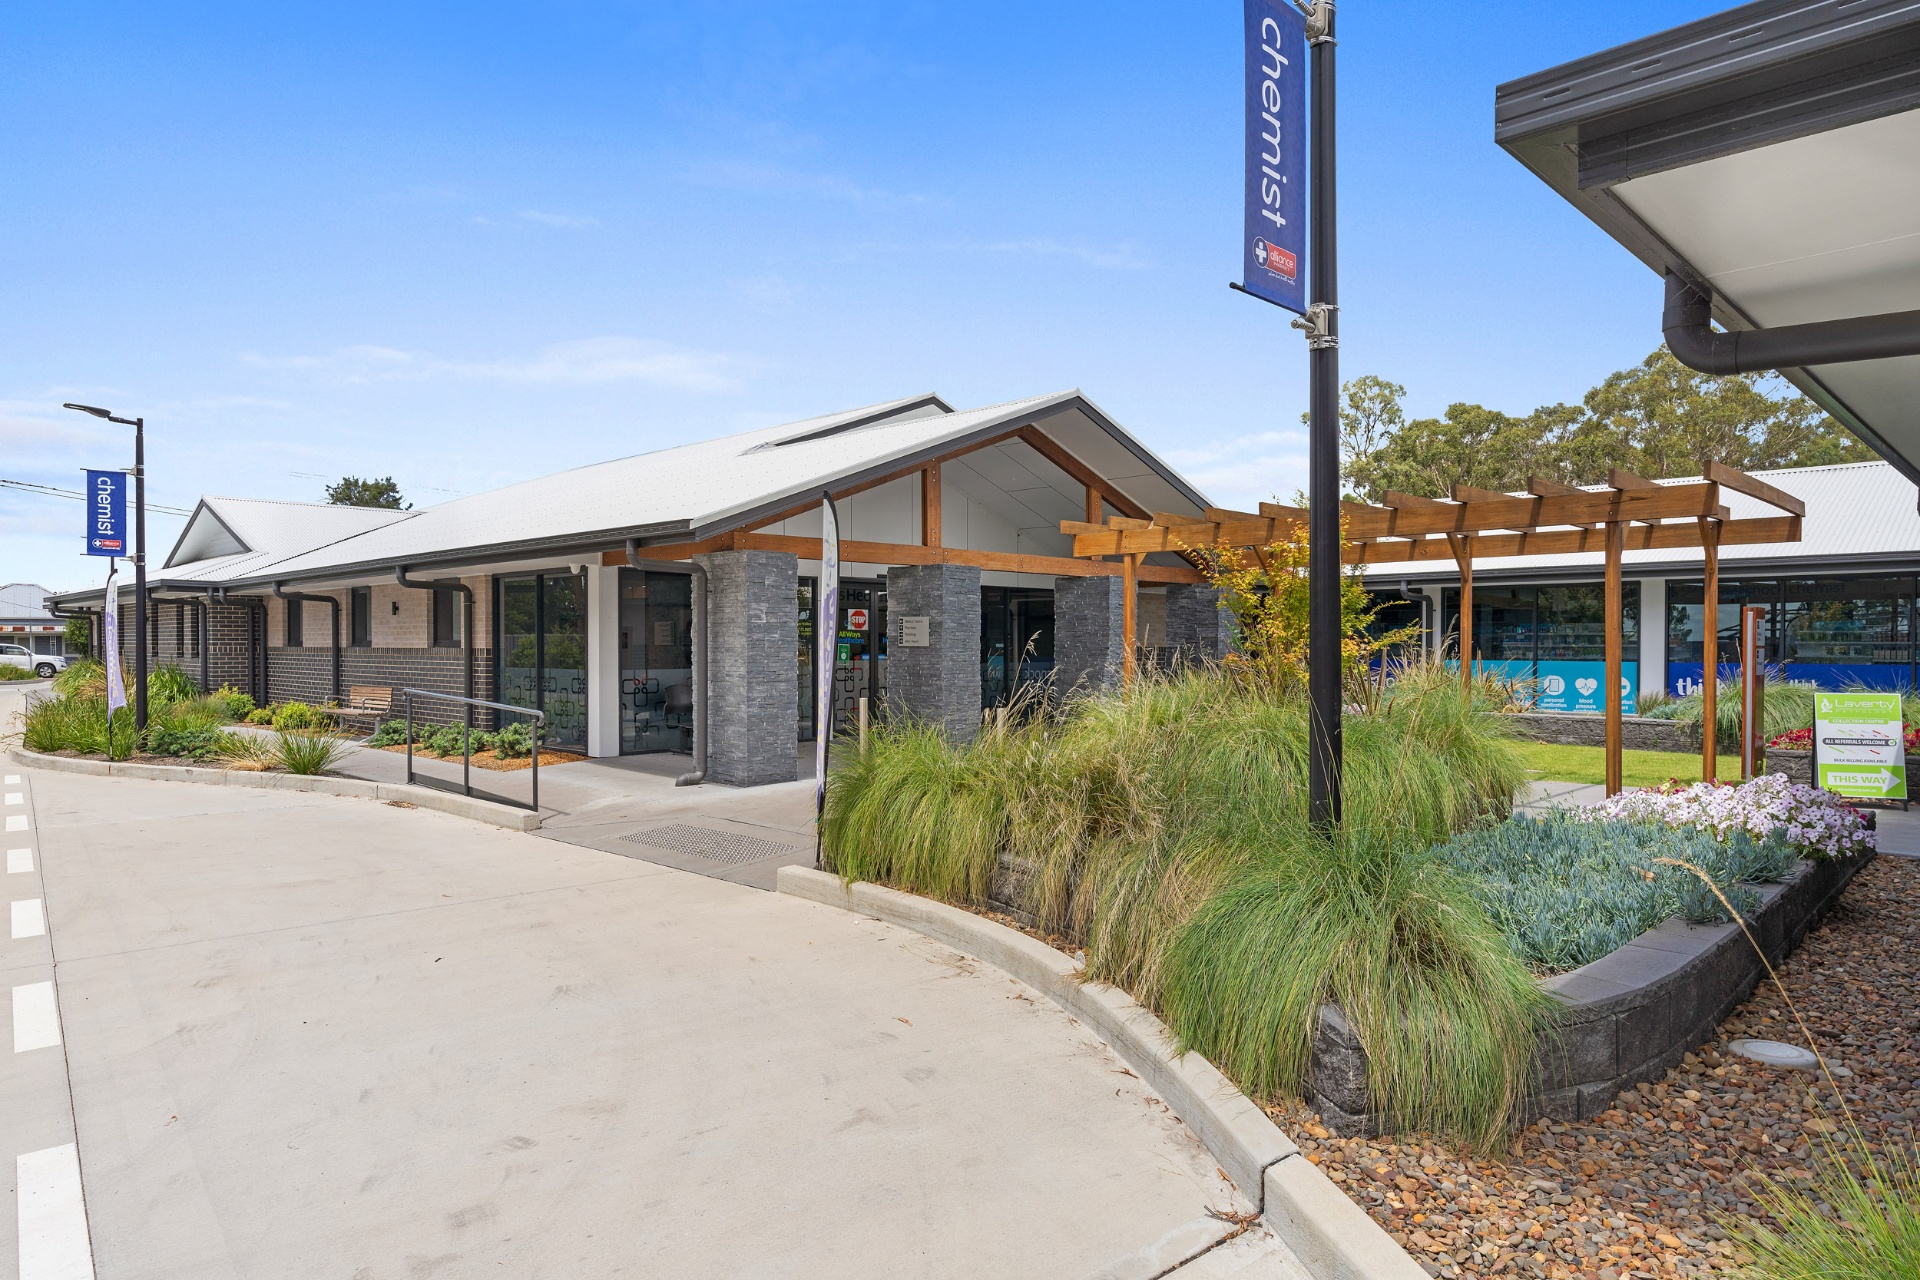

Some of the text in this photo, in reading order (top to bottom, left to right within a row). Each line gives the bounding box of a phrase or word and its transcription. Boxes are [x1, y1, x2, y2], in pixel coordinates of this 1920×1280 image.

[1261, 17, 1289, 229] chemist
[97, 476, 116, 536] chemist
[851, 616, 866, 624] STOP
[1789, 679, 1818, 690] think
[1835, 699, 1896, 709] Laverty
[1832, 775, 1888, 785] THIS WAY
